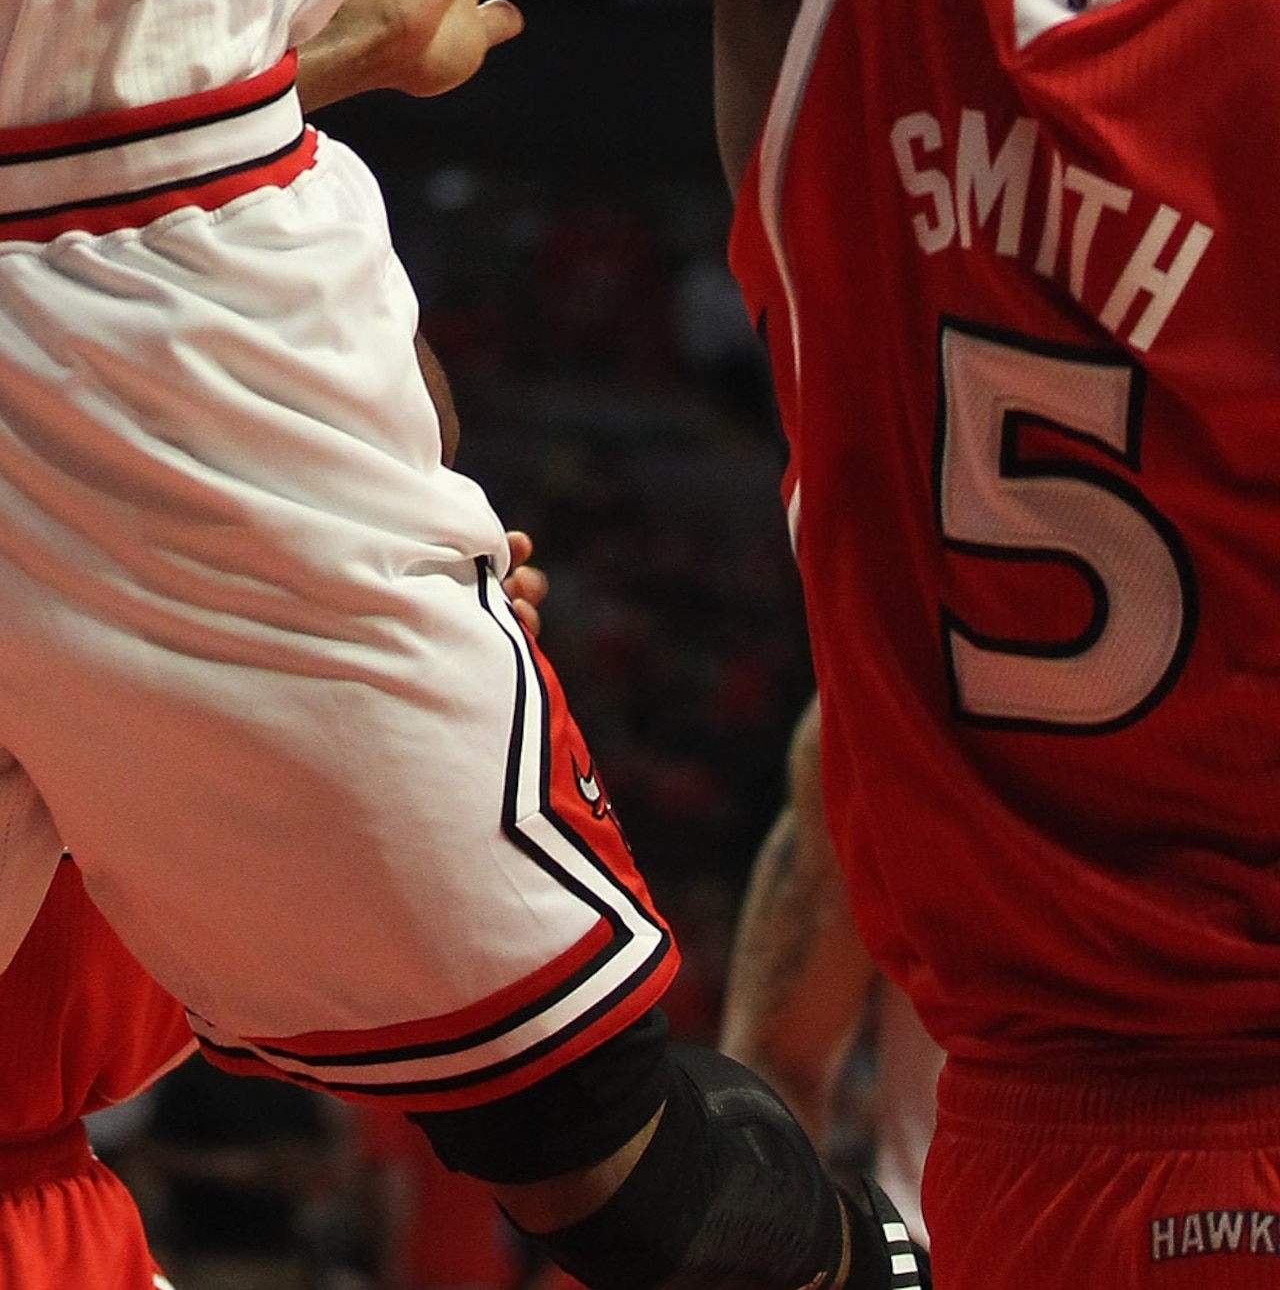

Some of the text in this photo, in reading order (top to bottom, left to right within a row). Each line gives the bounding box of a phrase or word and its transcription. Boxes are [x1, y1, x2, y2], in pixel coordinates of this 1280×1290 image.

[889, 106, 1216, 354] SMITH
[930, 313, 1200, 737] 5
[1150, 1209, 1280, 1262] HAWK
